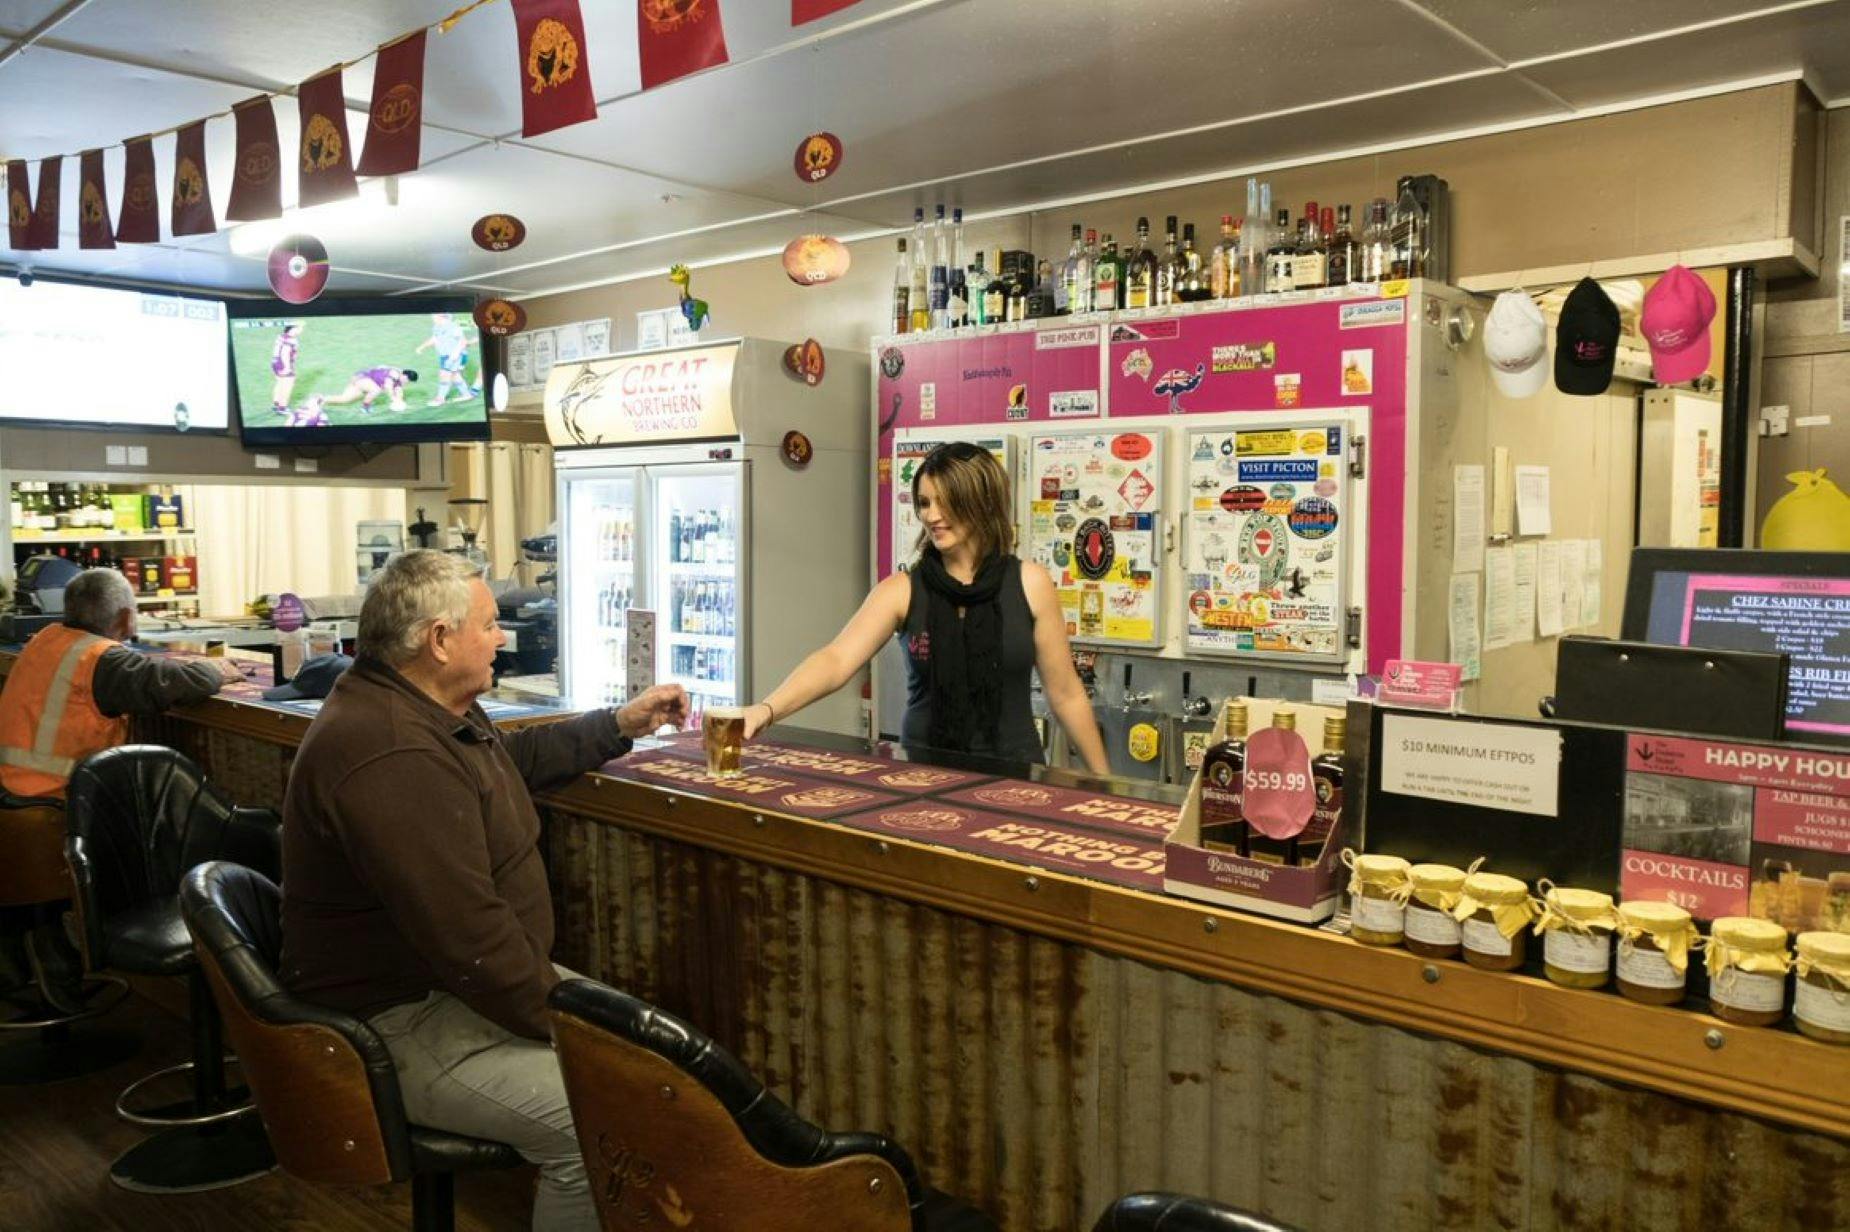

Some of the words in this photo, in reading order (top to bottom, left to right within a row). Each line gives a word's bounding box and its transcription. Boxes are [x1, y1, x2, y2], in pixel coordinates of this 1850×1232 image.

[622, 357, 708, 396] GREAT
[622, 393, 702, 417] NORTHERN
[634, 417, 678, 432] BREWING
[1242, 464, 1270, 472] VISIT
[1273, 463, 1315, 473] PICTON
[1732, 595, 1768, 607] CHEZ
[1771, 597, 1820, 609] SABINE
[1806, 667, 1830, 679] RIB
[1401, 738, 1423, 752] $10
[1425, 742, 1487, 760] MINIMUM
[1489, 749, 1536, 765] EFTPOS
[1704, 747, 1790, 773] HAPPY
[1246, 771, 1307, 792] $59.99
[1772, 790, 1798, 804] TAP
[1800, 793, 1834, 807] BEER
[1805, 812, 1837, 825] JUGS
[997, 823, 1139, 854] NOTHING
[1625, 857, 1745, 889] COCKTAILS
[1666, 890, 1699, 909] $12
